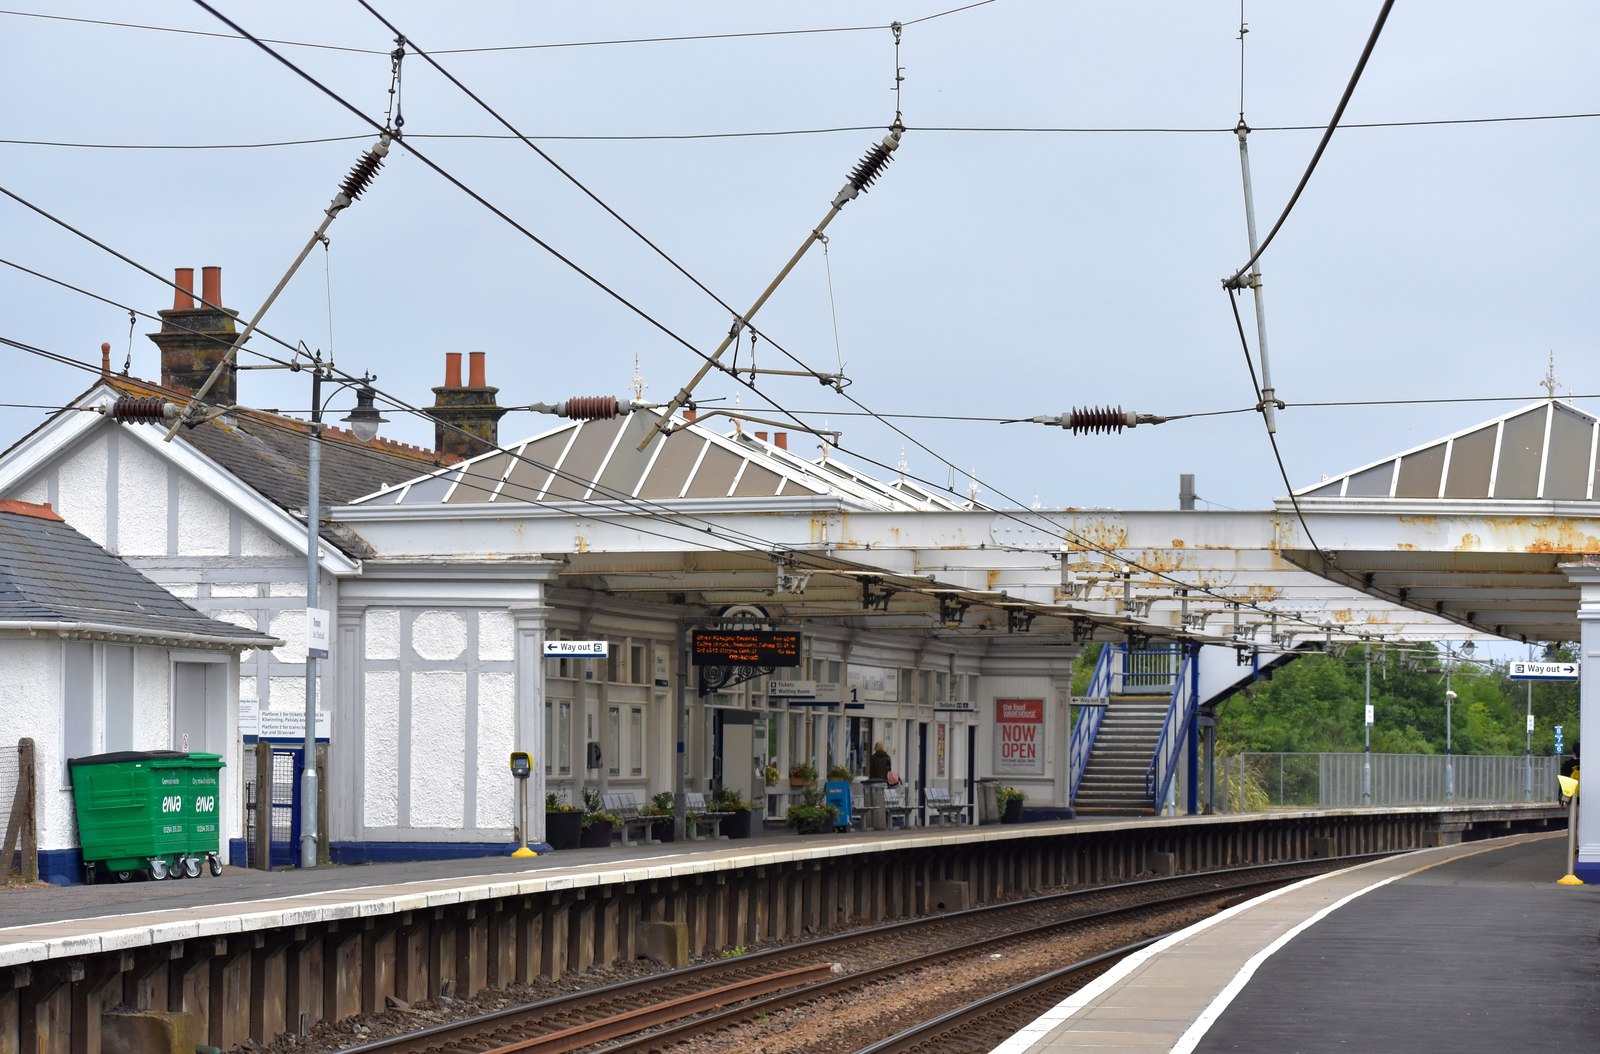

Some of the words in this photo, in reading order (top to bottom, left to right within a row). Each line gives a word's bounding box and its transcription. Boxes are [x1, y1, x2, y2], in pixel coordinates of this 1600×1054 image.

[560, 643, 576, 652] Way
[577, 643, 591, 651] out
[1527, 664, 1545, 674] Way
[1546, 665, 1560, 673] out
[850, 688, 858, 702] 1
[1003, 703, 1012, 711] the
[1013, 703, 1026, 711] food
[1003, 710, 1037, 719] WAREHOUSE
[1002, 724, 1036, 742] NOW
[1002, 743, 1036, 759] OPEN
[162, 795, 182, 813] enva
[195, 795, 214, 813] enva
